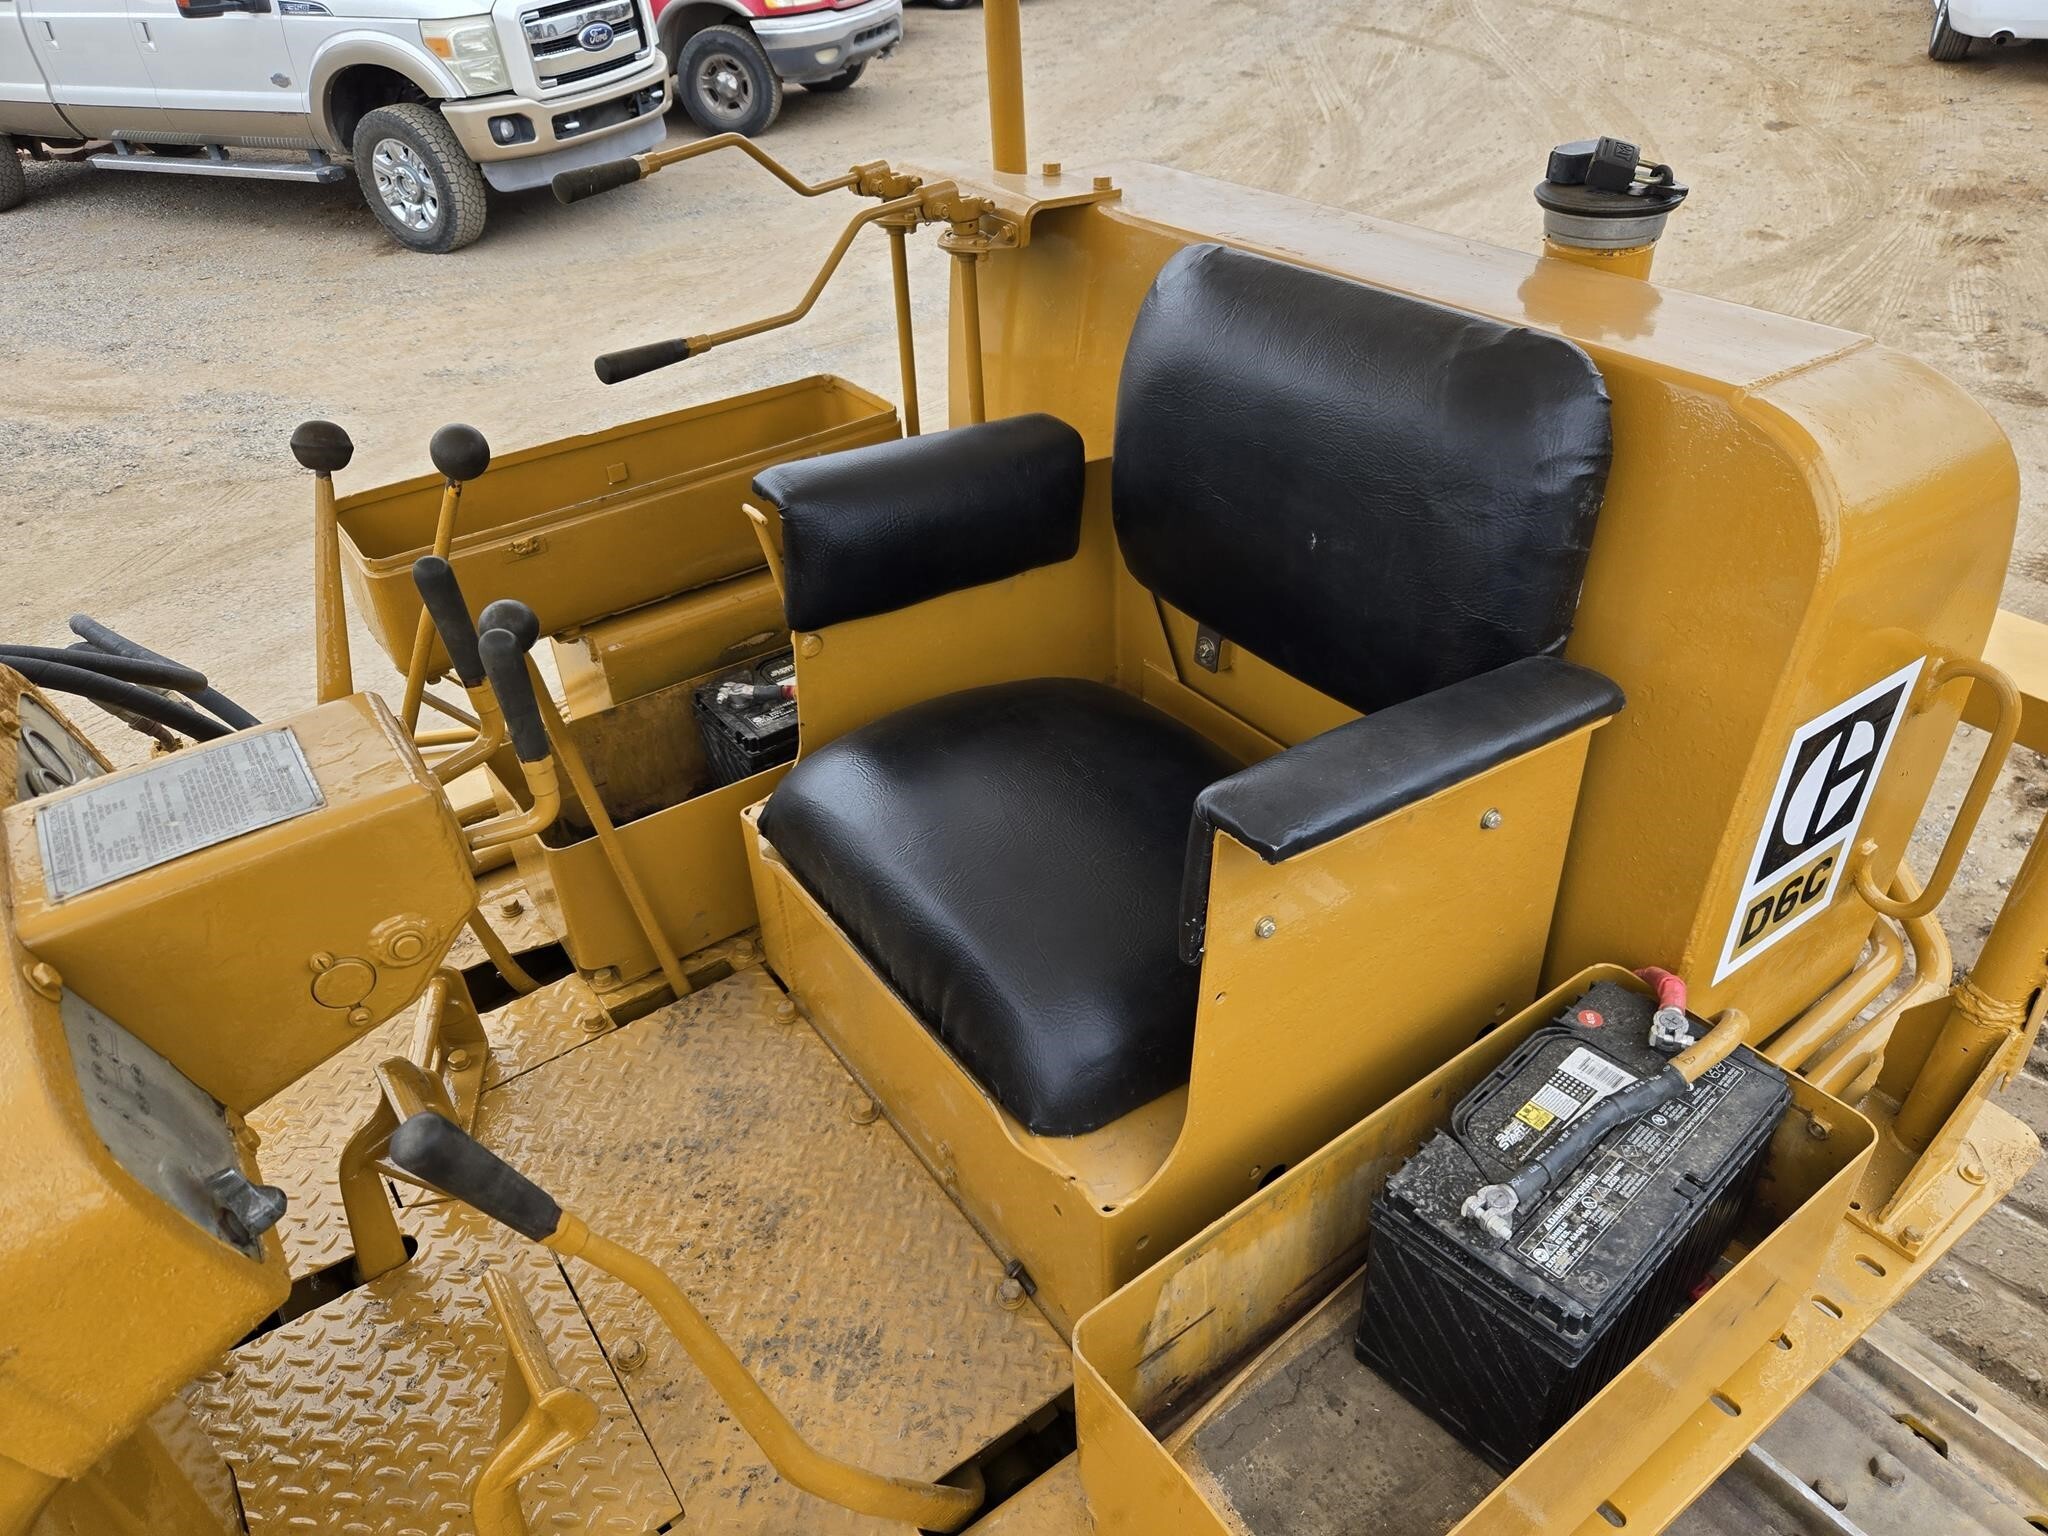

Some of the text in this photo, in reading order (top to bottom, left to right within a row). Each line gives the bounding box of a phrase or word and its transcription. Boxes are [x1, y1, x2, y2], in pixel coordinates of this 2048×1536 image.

[590, 27, 608, 44] Ford
[1737, 856, 1834, 949] D6C
[1547, 1173, 1599, 1226] DANGER/POISON
[1545, 1240, 1573, 1268] EXPLOSIVE
[1570, 1224, 1588, 1242] GASES
[1549, 1221, 1568, 1241] SHIELD
